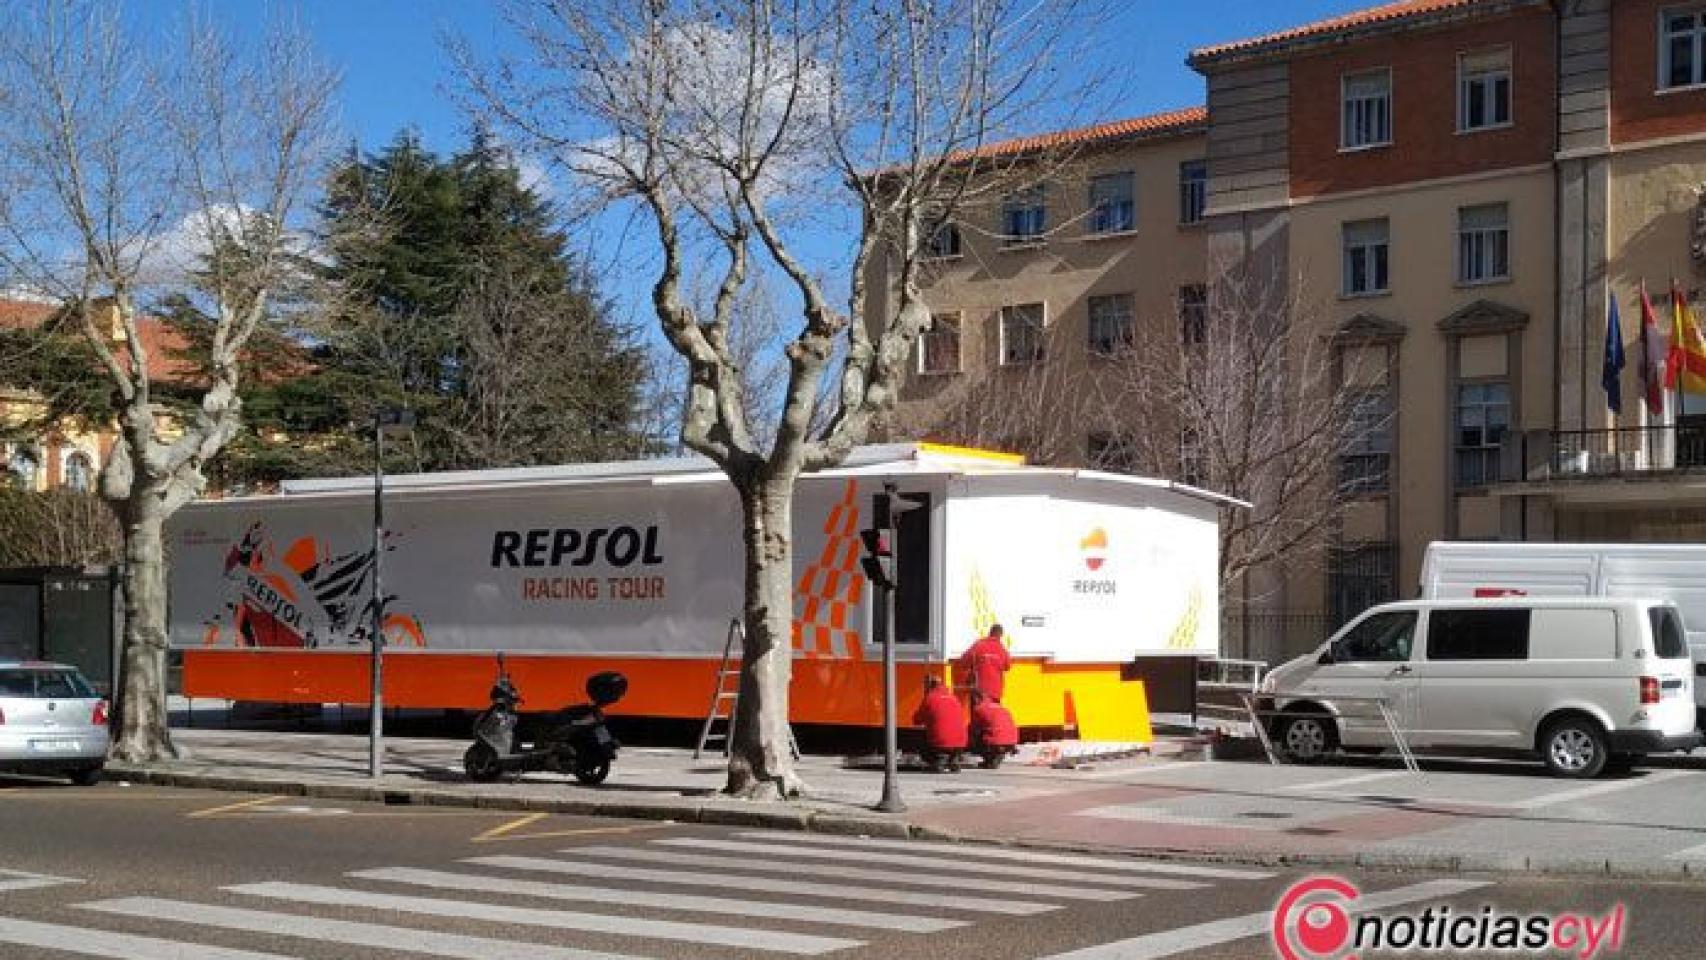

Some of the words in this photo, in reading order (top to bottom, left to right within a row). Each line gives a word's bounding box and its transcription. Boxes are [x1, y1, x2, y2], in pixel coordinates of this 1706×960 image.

[491, 526, 664, 567] REPSOL
[246, 575, 304, 629] REPSOL
[523, 577, 599, 599] RACING
[607, 576, 666, 598] TOUR
[1073, 579, 1117, 595] REPSOL
